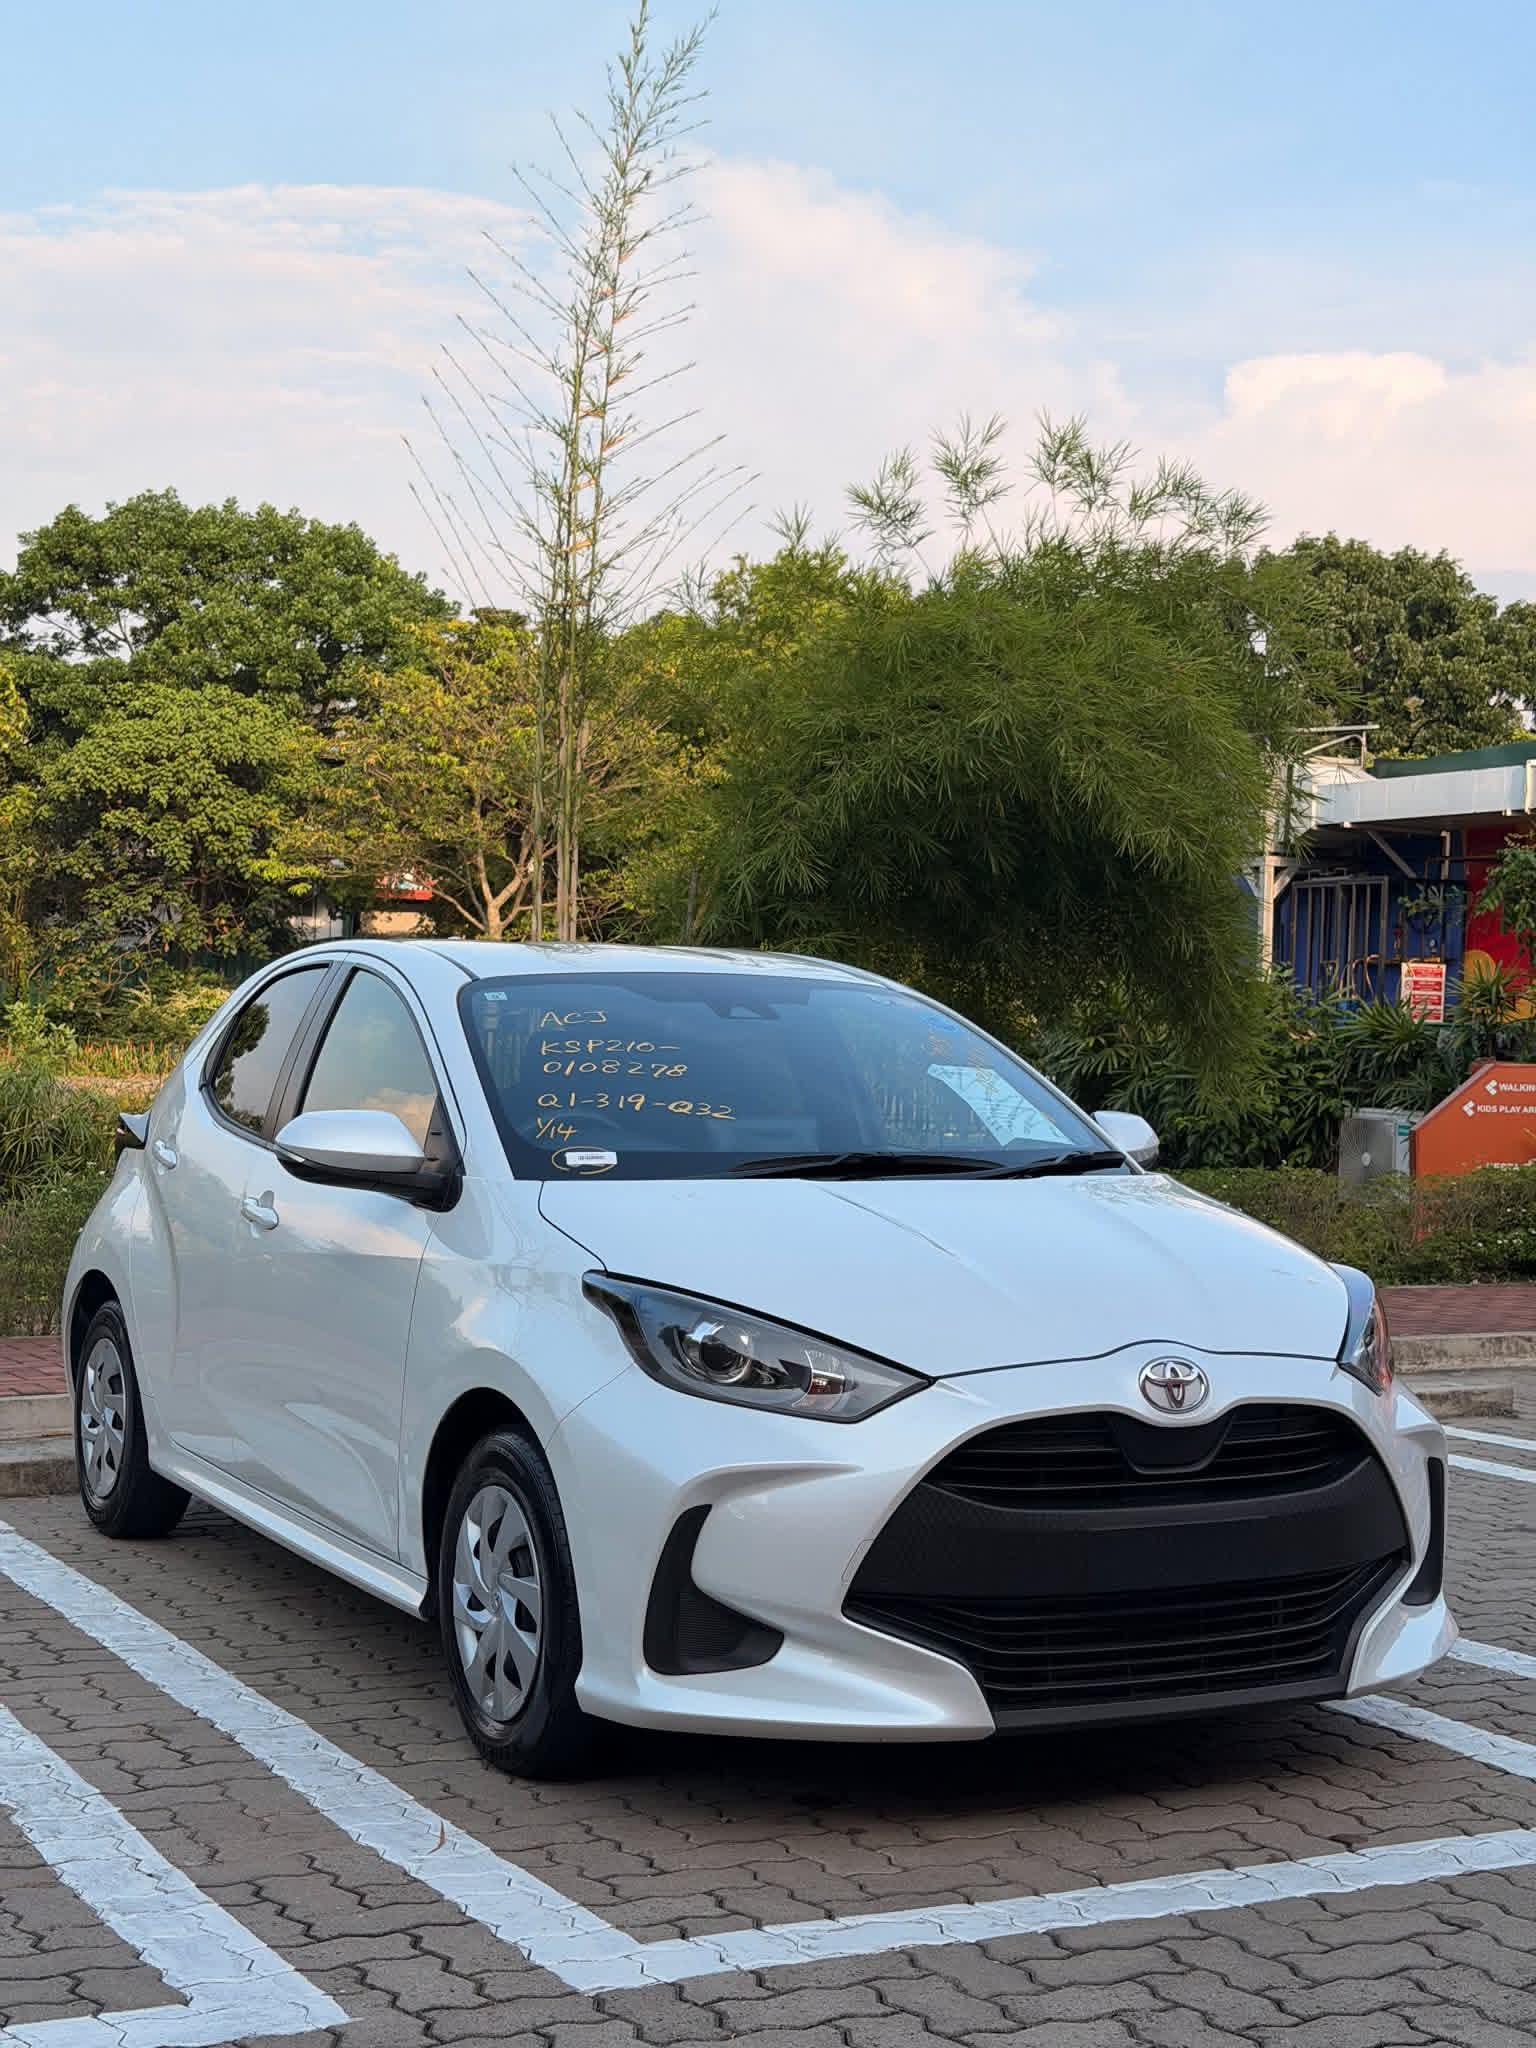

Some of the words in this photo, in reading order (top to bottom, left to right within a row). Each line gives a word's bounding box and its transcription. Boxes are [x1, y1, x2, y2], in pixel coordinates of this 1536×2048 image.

[543, 1060, 688, 1078] 0108278
[1477, 1104, 1498, 1113] KIDS
[1499, 1104, 1521, 1113] PLAY
